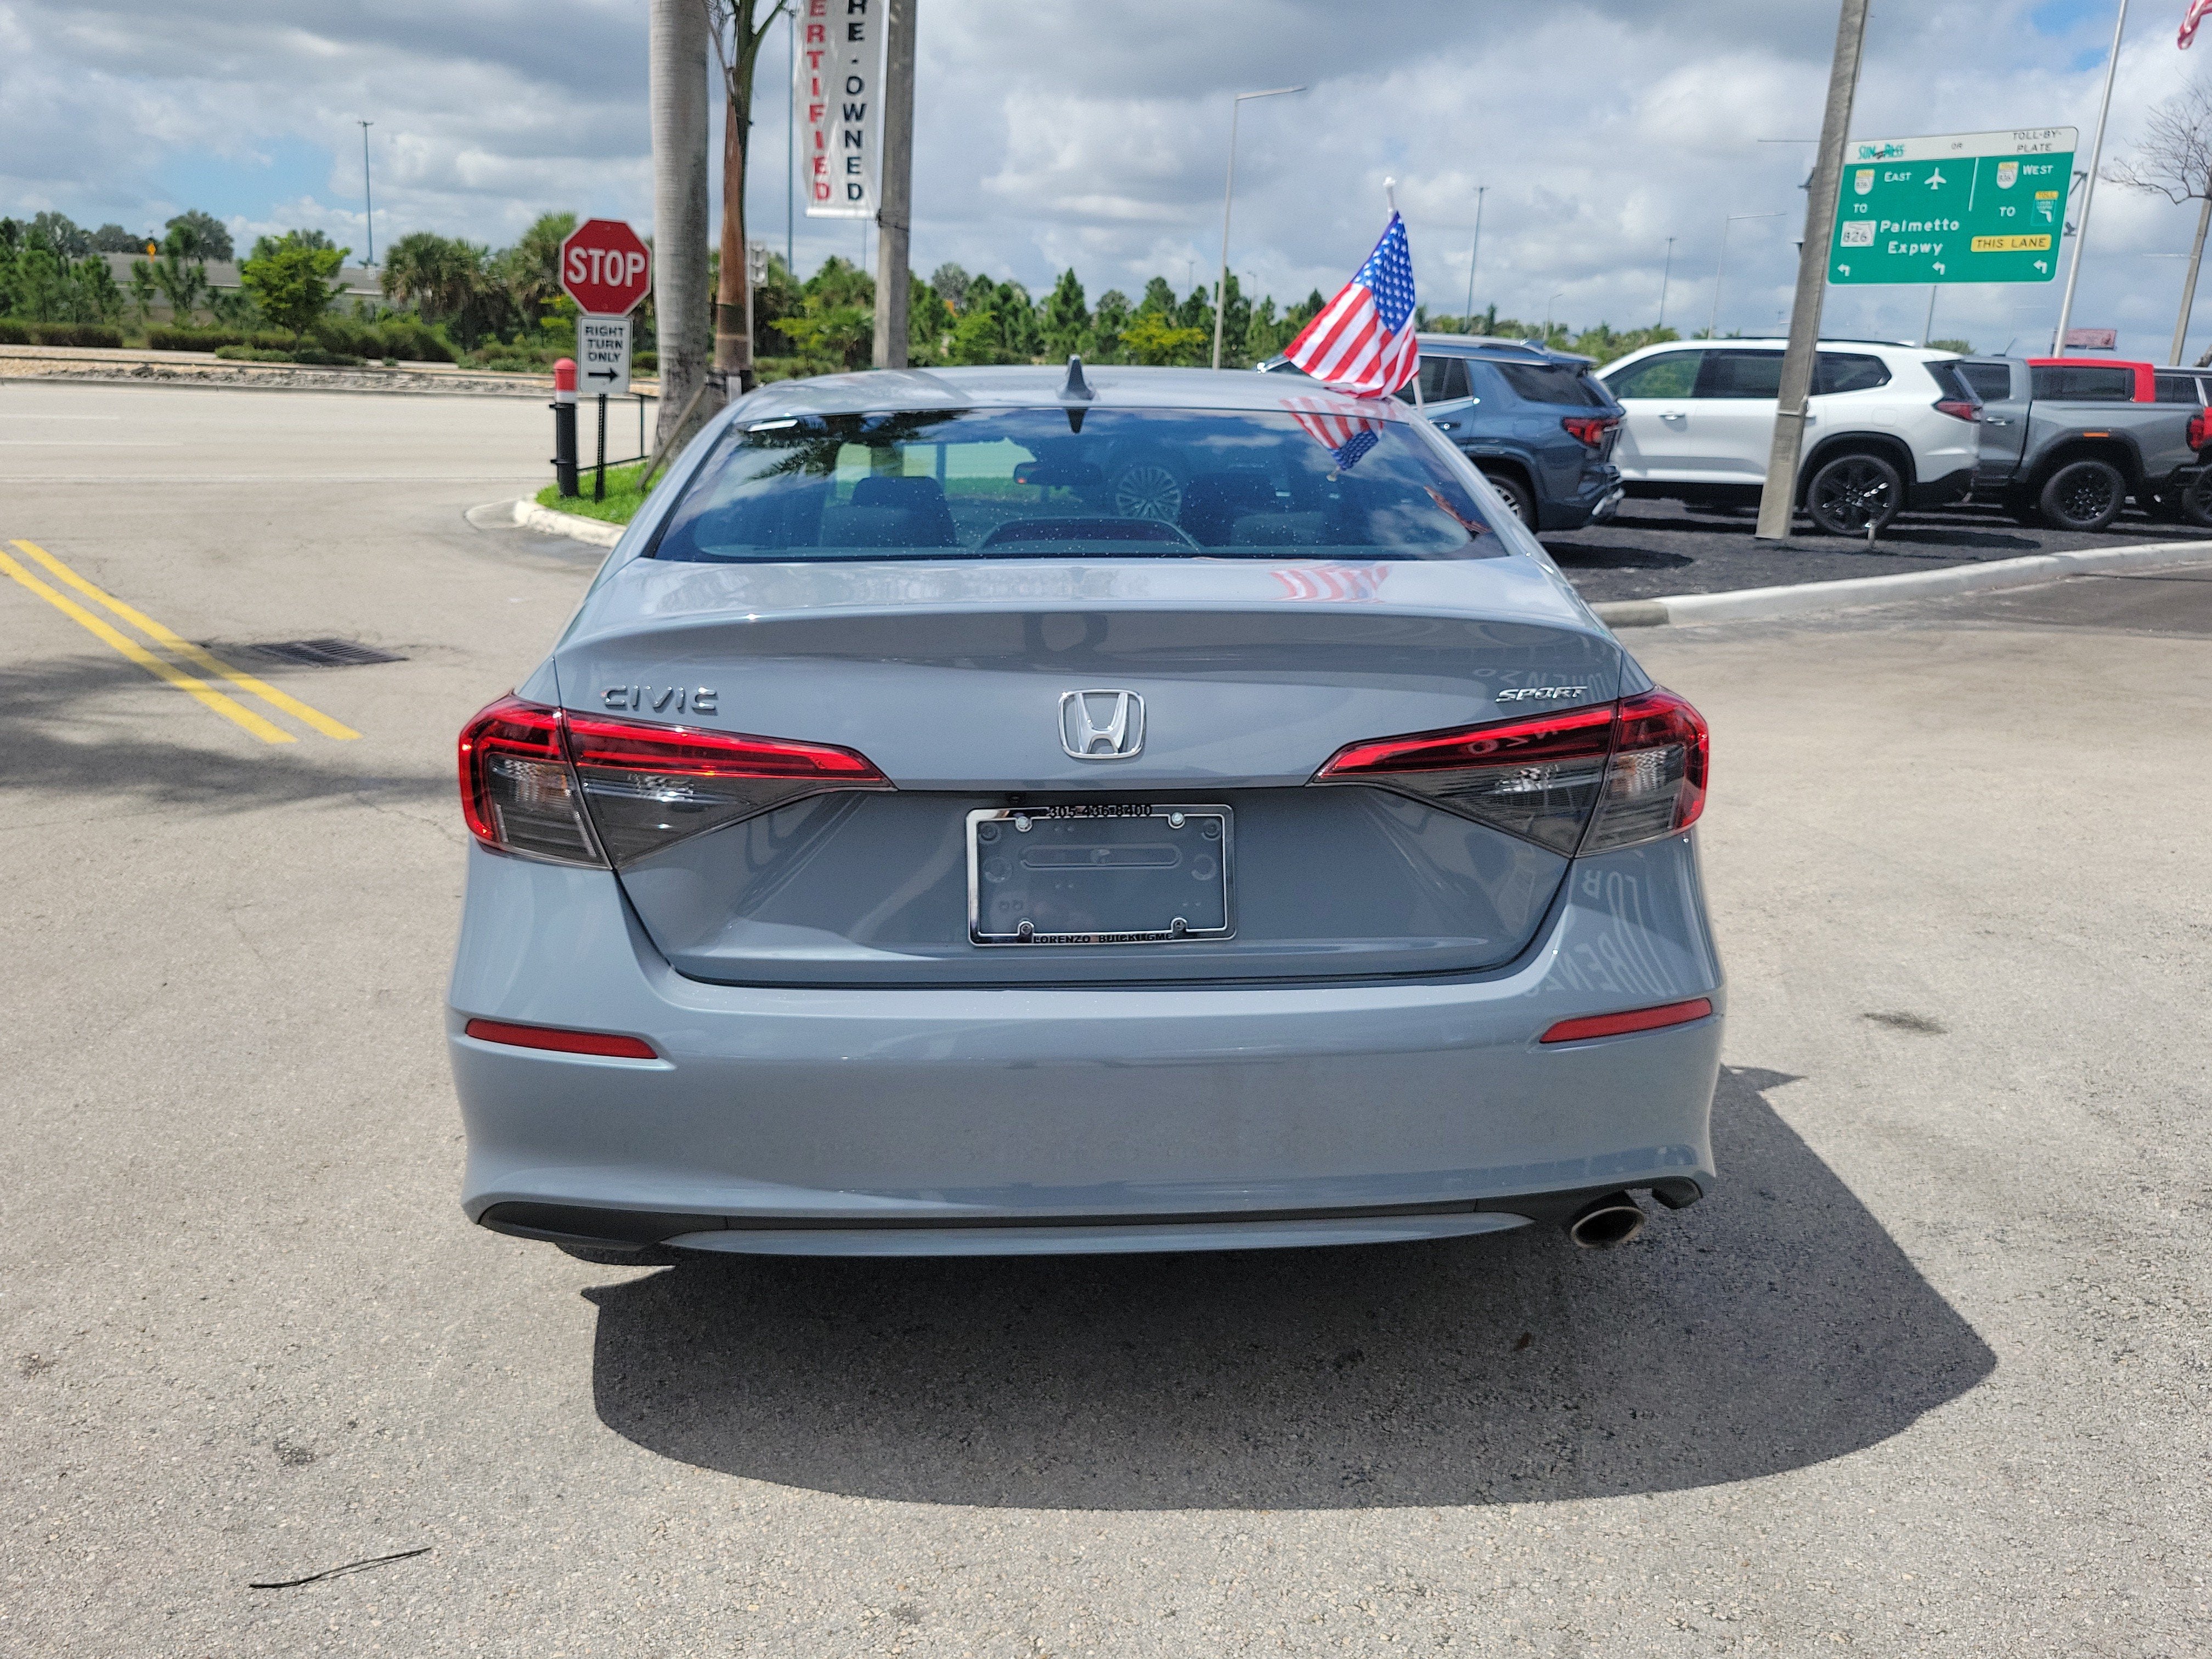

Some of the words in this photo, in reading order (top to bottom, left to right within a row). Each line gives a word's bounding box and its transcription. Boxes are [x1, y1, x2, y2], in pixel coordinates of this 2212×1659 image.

[2017, 143, 2052, 152] PLATE
[2023, 165, 2054, 175] WEST
[1884, 171, 1912, 182] EAST
[1853, 202, 1868, 213] TO
[1999, 206, 2016, 217] TO
[1880, 218, 1960, 233] Palmetto
[1888, 240, 1944, 257] Expwy
[1977, 239, 2004, 249] THIS
[2011, 238, 2046, 248] LANE
[567, 246, 646, 287] STOP
[585, 326, 623, 337] RIGHT
[588, 339, 623, 349] TURN
[588, 352, 621, 363] ONLY
[602, 685, 718, 715] CIVIC
[1495, 686, 1588, 703] SPORT
[1033, 934, 1091, 944] LORENZO
